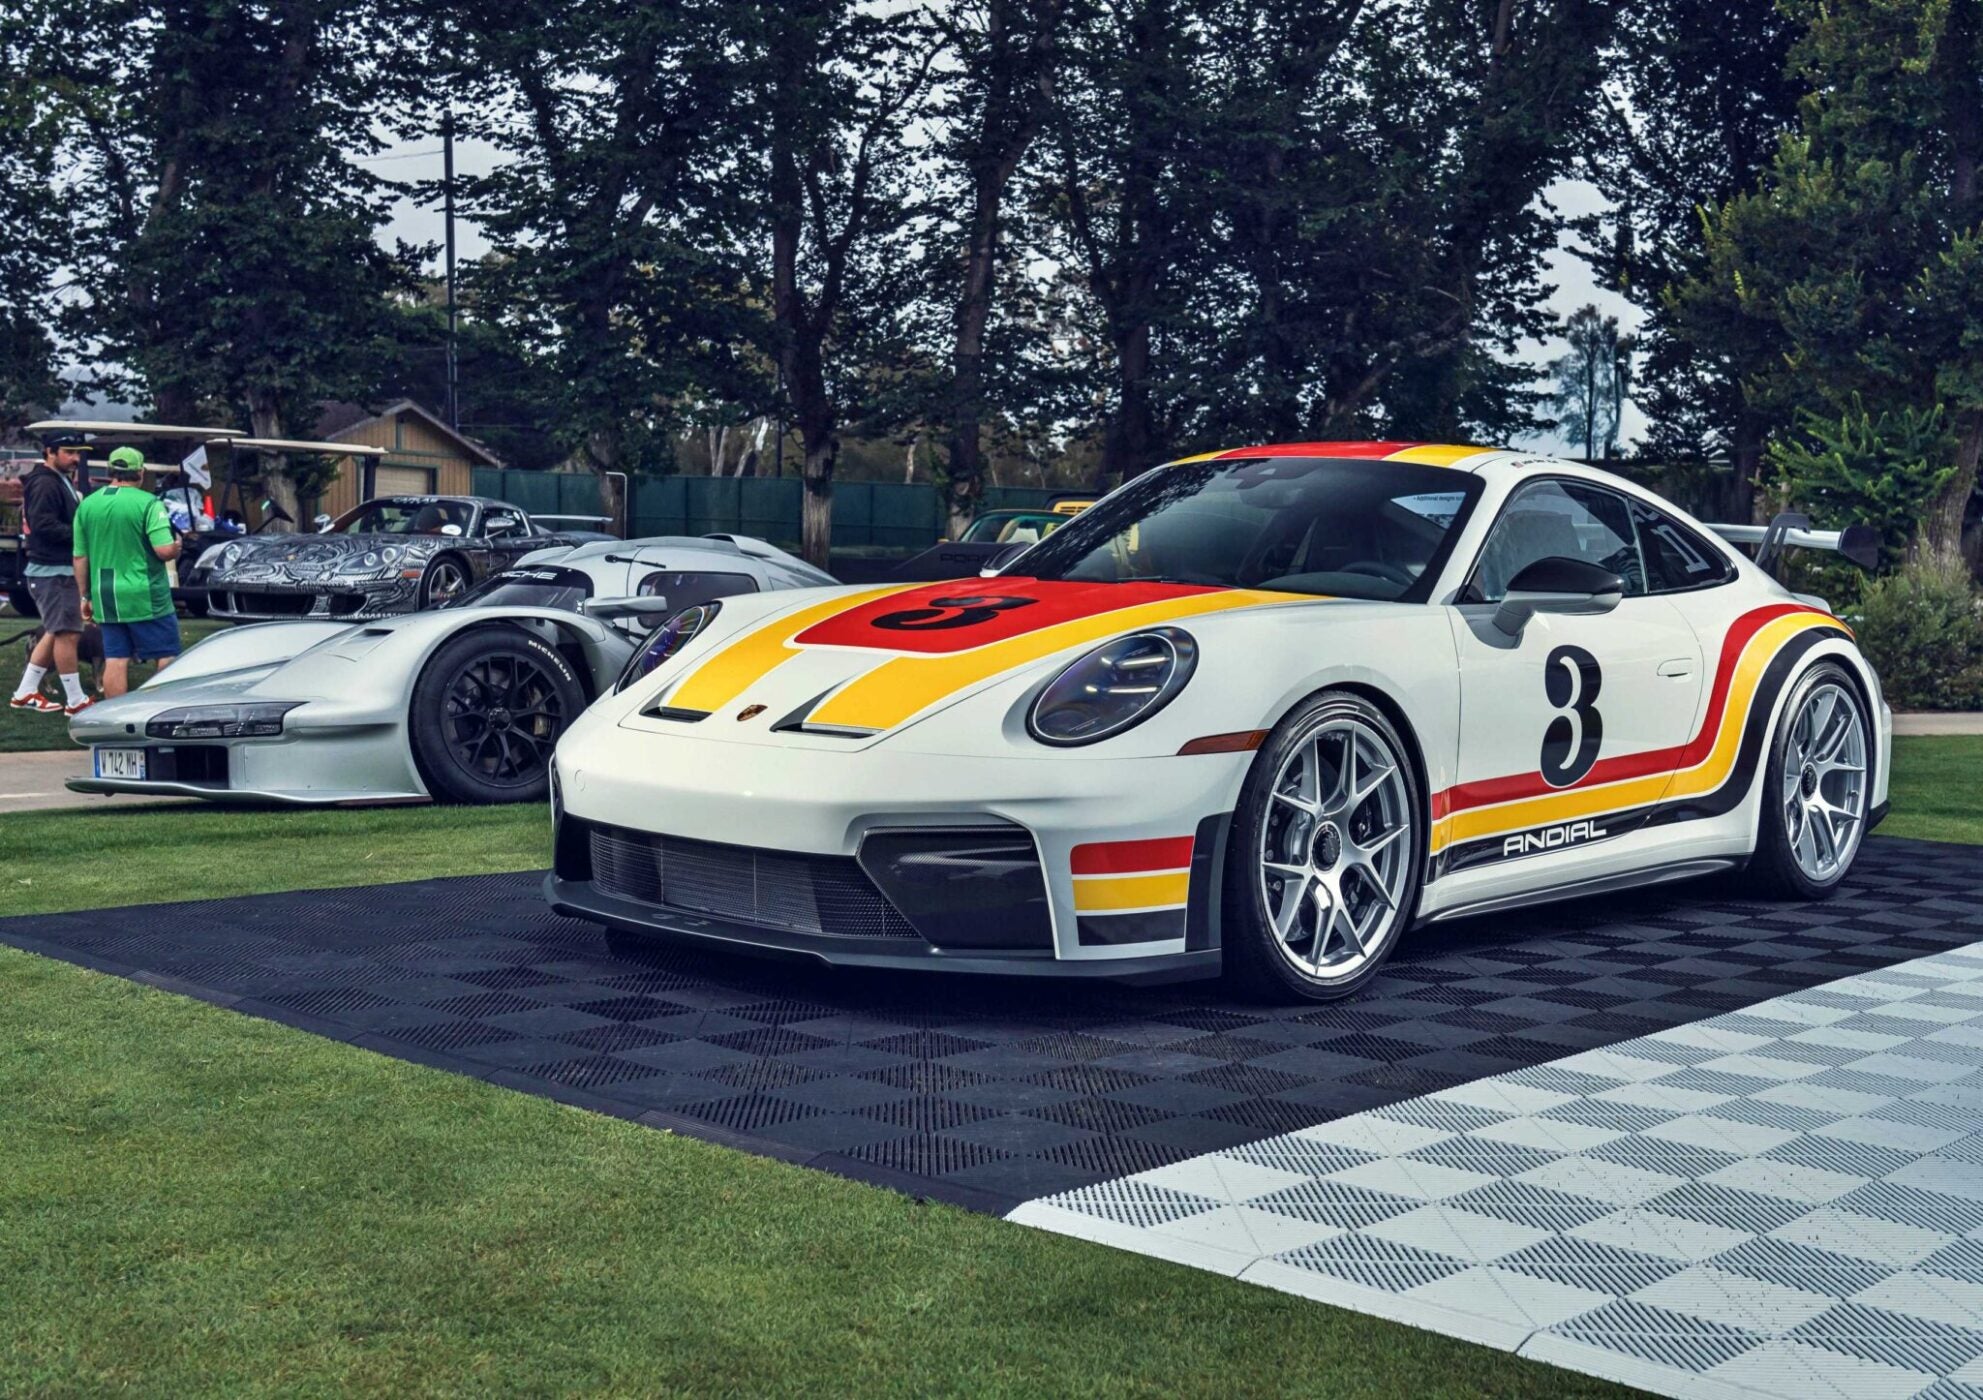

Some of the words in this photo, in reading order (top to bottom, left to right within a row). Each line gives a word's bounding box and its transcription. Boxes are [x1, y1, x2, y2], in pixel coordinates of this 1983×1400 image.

[870, 595, 1041, 630] 3
[528, 640, 571, 681] MICHELIN
[1541, 645, 1603, 788] 3
[1504, 820, 1607, 857] ANDIAL
